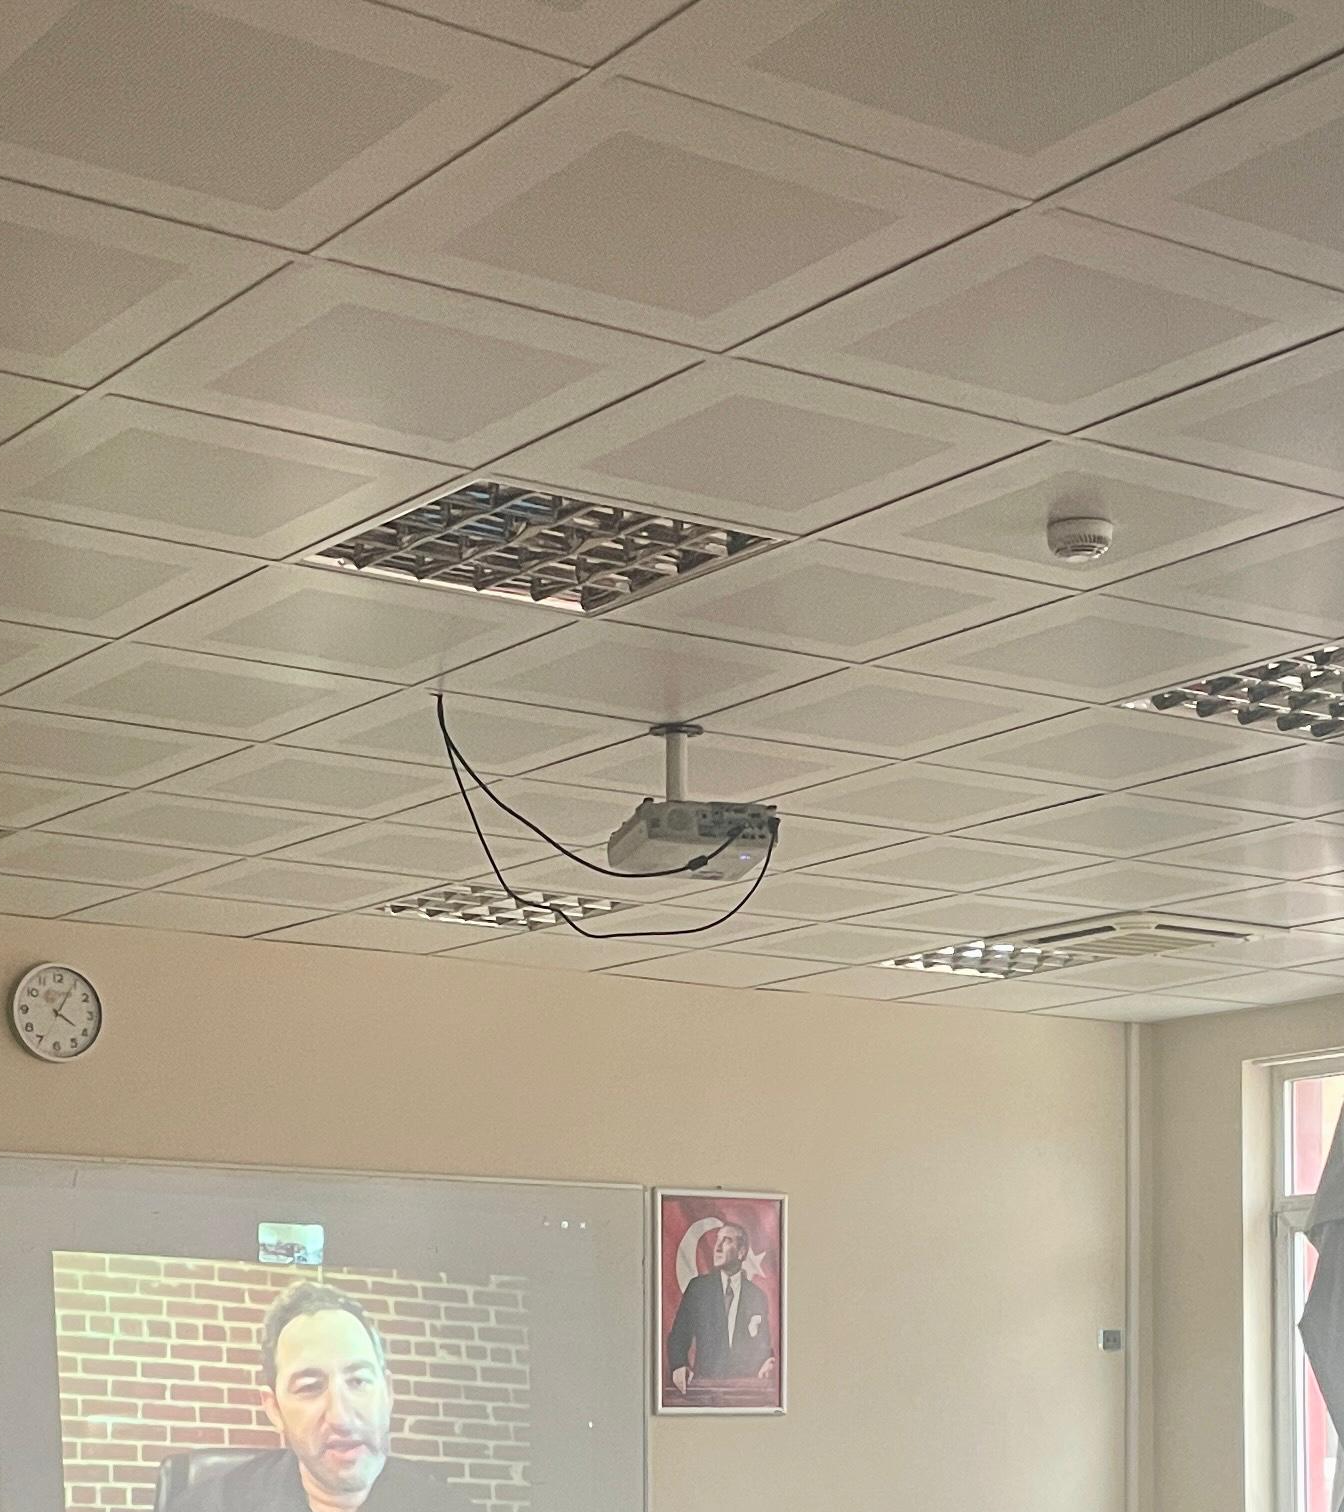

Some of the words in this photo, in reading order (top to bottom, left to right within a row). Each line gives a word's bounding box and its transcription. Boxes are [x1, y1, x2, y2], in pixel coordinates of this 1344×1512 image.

[38, 976, 46, 986] 11
[53, 973, 64, 983] 12
[27, 987, 39, 998] 10
[81, 993, 89, 1003] 2
[20, 1004, 29, 1014] 9
[87, 1011, 94, 1021] 3
[25, 1022, 34, 1032] 8
[81, 1028, 89, 1037] 4
[36, 1034, 44, 1044] 7
[70, 1038, 78, 1048] 5
[52, 1041, 61, 1051] 6
